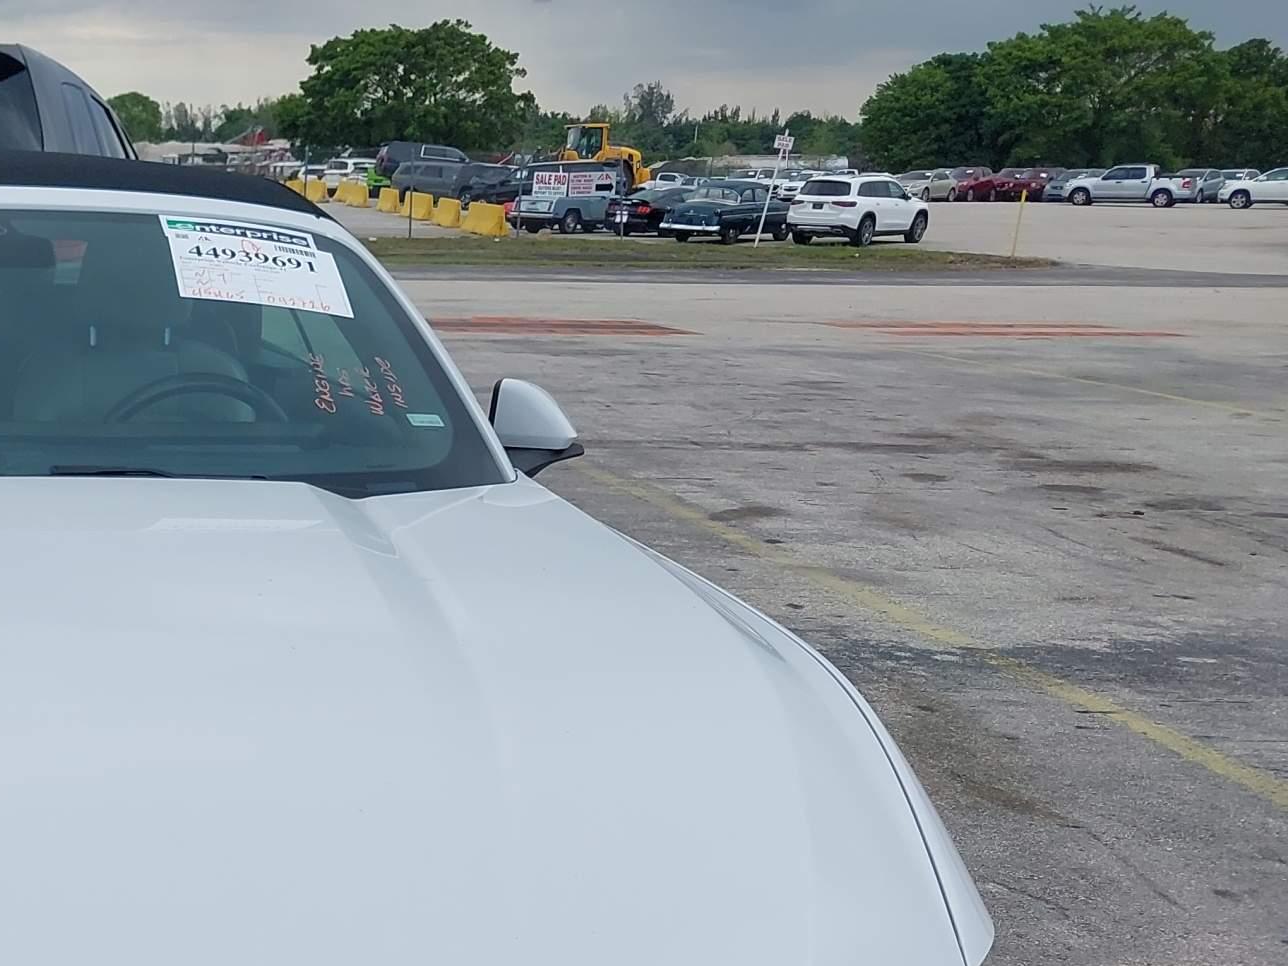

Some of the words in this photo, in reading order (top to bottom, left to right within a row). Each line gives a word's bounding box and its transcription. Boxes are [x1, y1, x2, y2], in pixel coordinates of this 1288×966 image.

[535, 173, 552, 185] SALE
[553, 174, 567, 186] PAD
[170, 223, 309, 247] enterprise
[188, 245, 318, 273] 44939691
